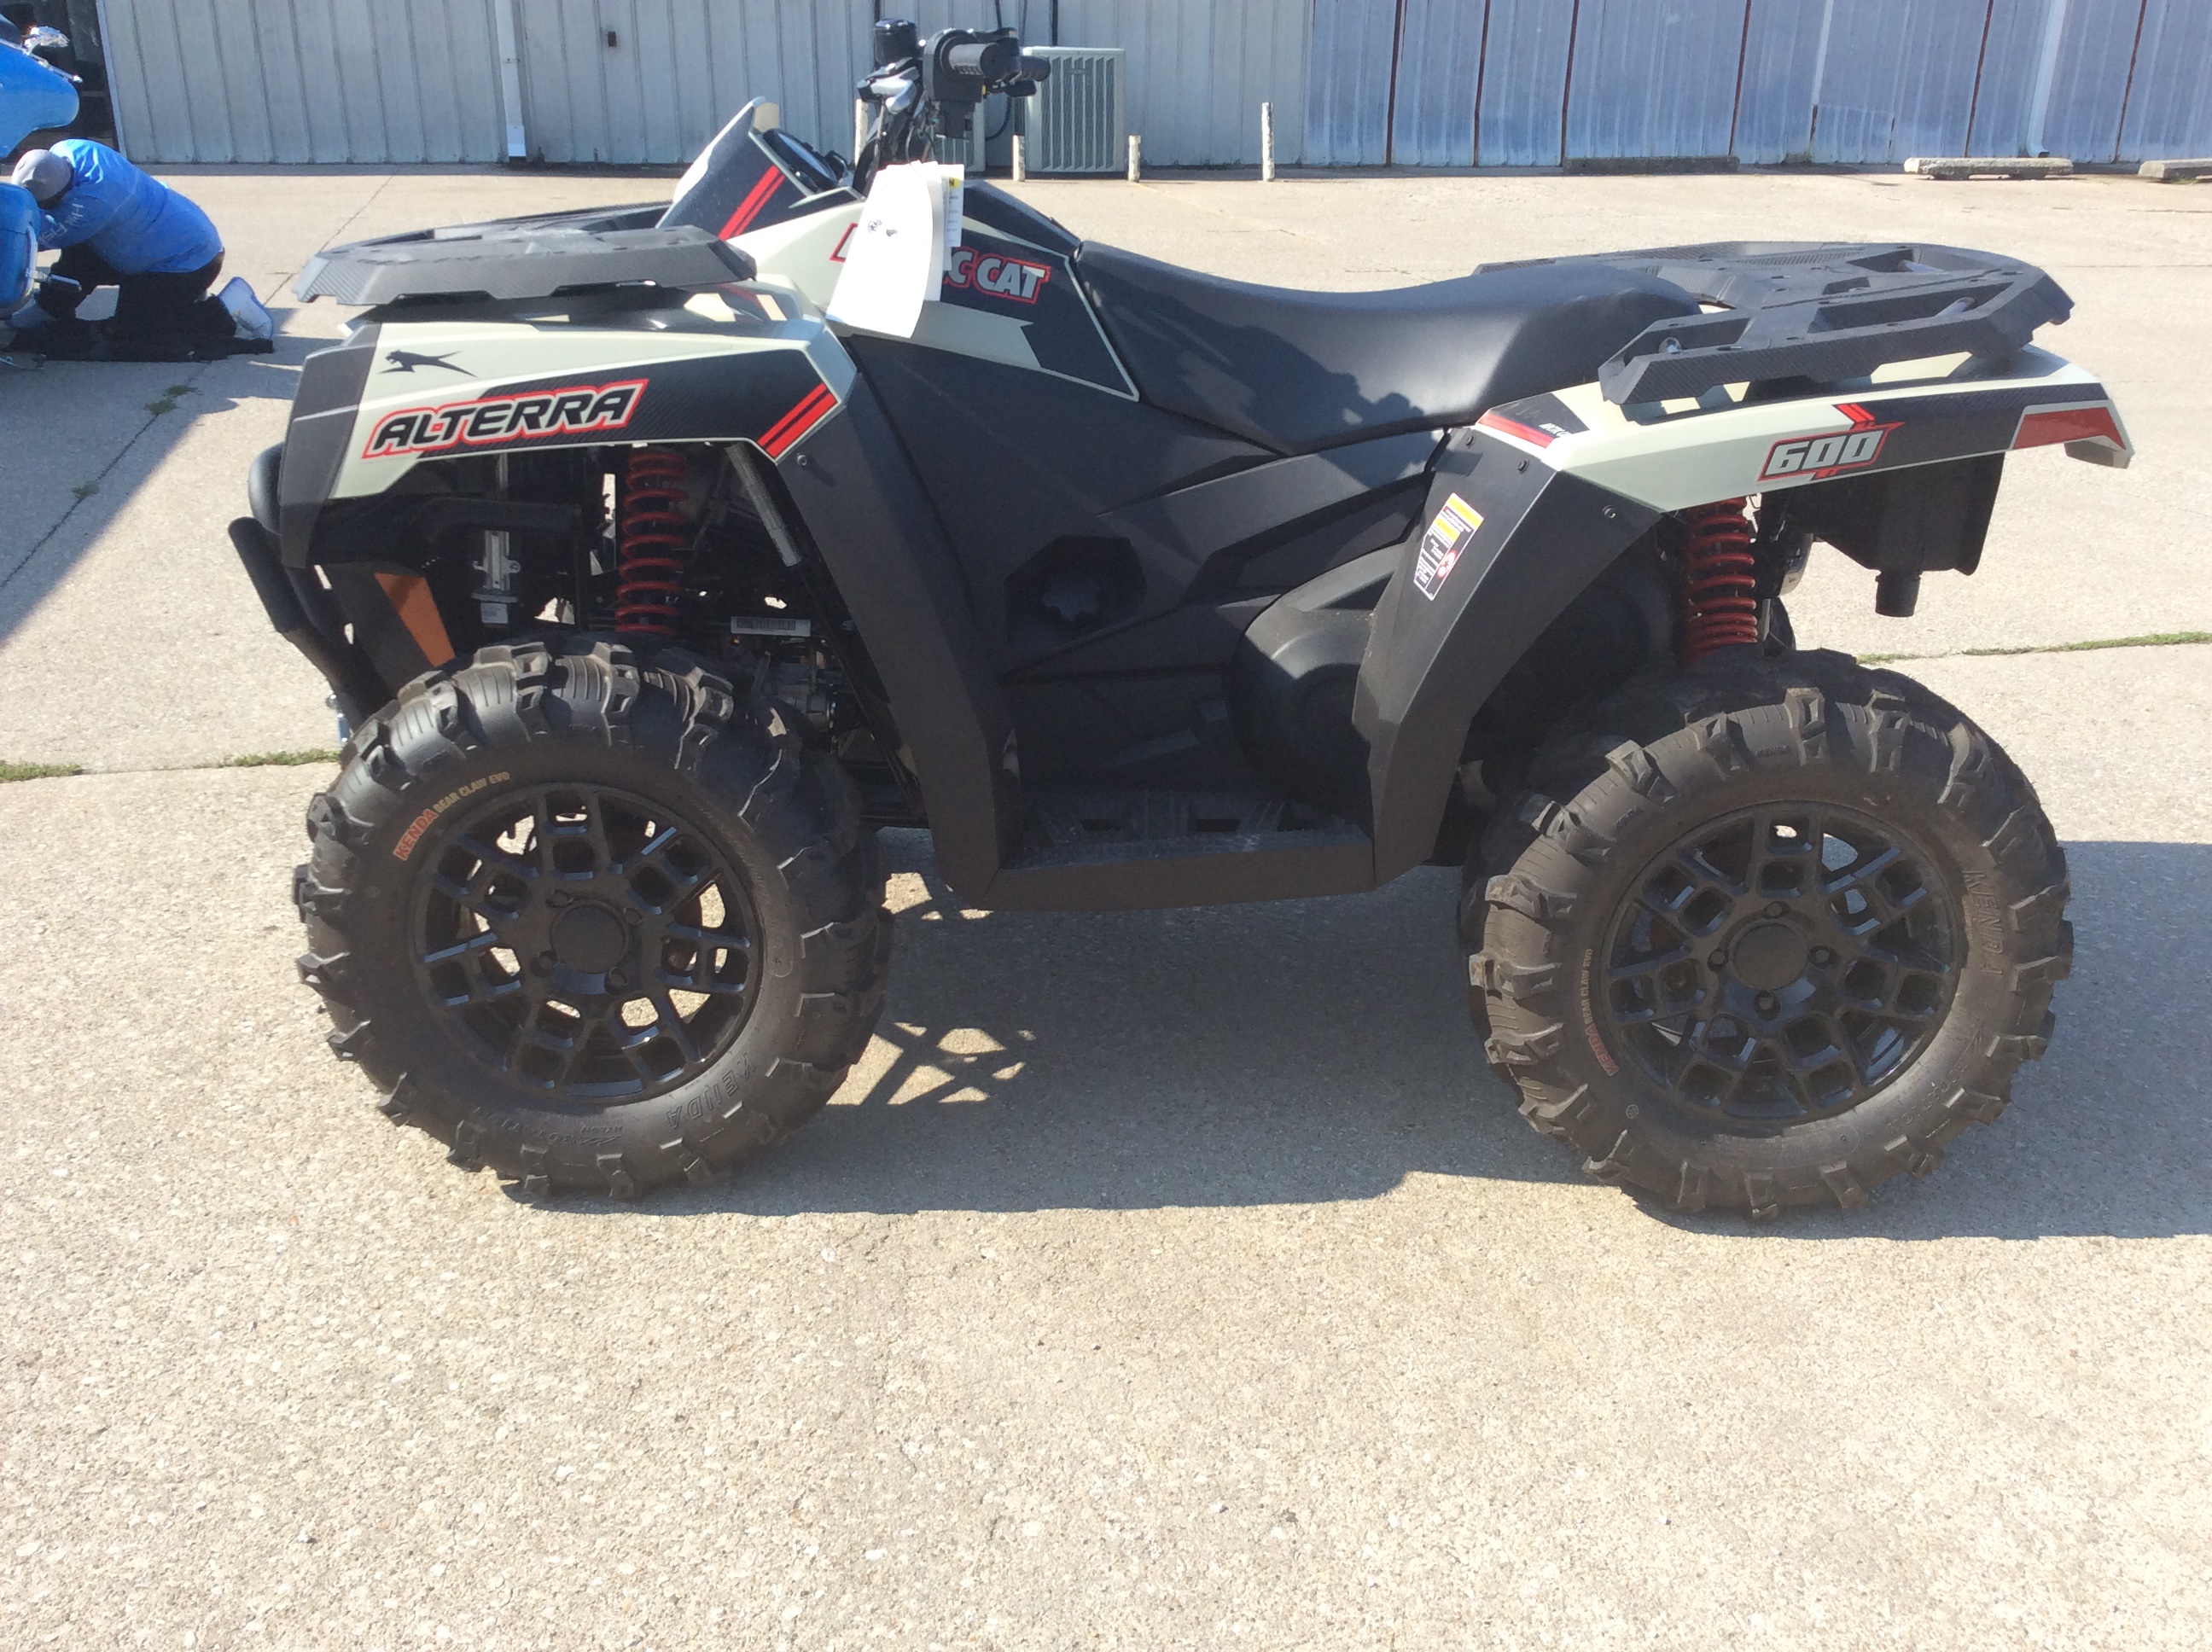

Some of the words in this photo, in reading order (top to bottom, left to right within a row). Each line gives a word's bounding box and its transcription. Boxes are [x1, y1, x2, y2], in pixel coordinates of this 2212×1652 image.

[975, 256, 1046, 300] CAT
[367, 383, 642, 455] ALTERRA
[1764, 429, 1885, 476] 600
[393, 808, 439, 861] KENDA
[433, 792, 461, 813] BEAR
[458, 777, 487, 797] CLAW
[488, 771, 511, 784] EVO
[1963, 870, 2004, 974] KENDA
[1582, 948, 1593, 967] EVO
[1580, 969, 1591, 997] CLAW
[1580, 999, 1593, 1025] BEAR
[1585, 1023, 1620, 1076] KENDA
[666, 1052, 756, 1130] KENDA
